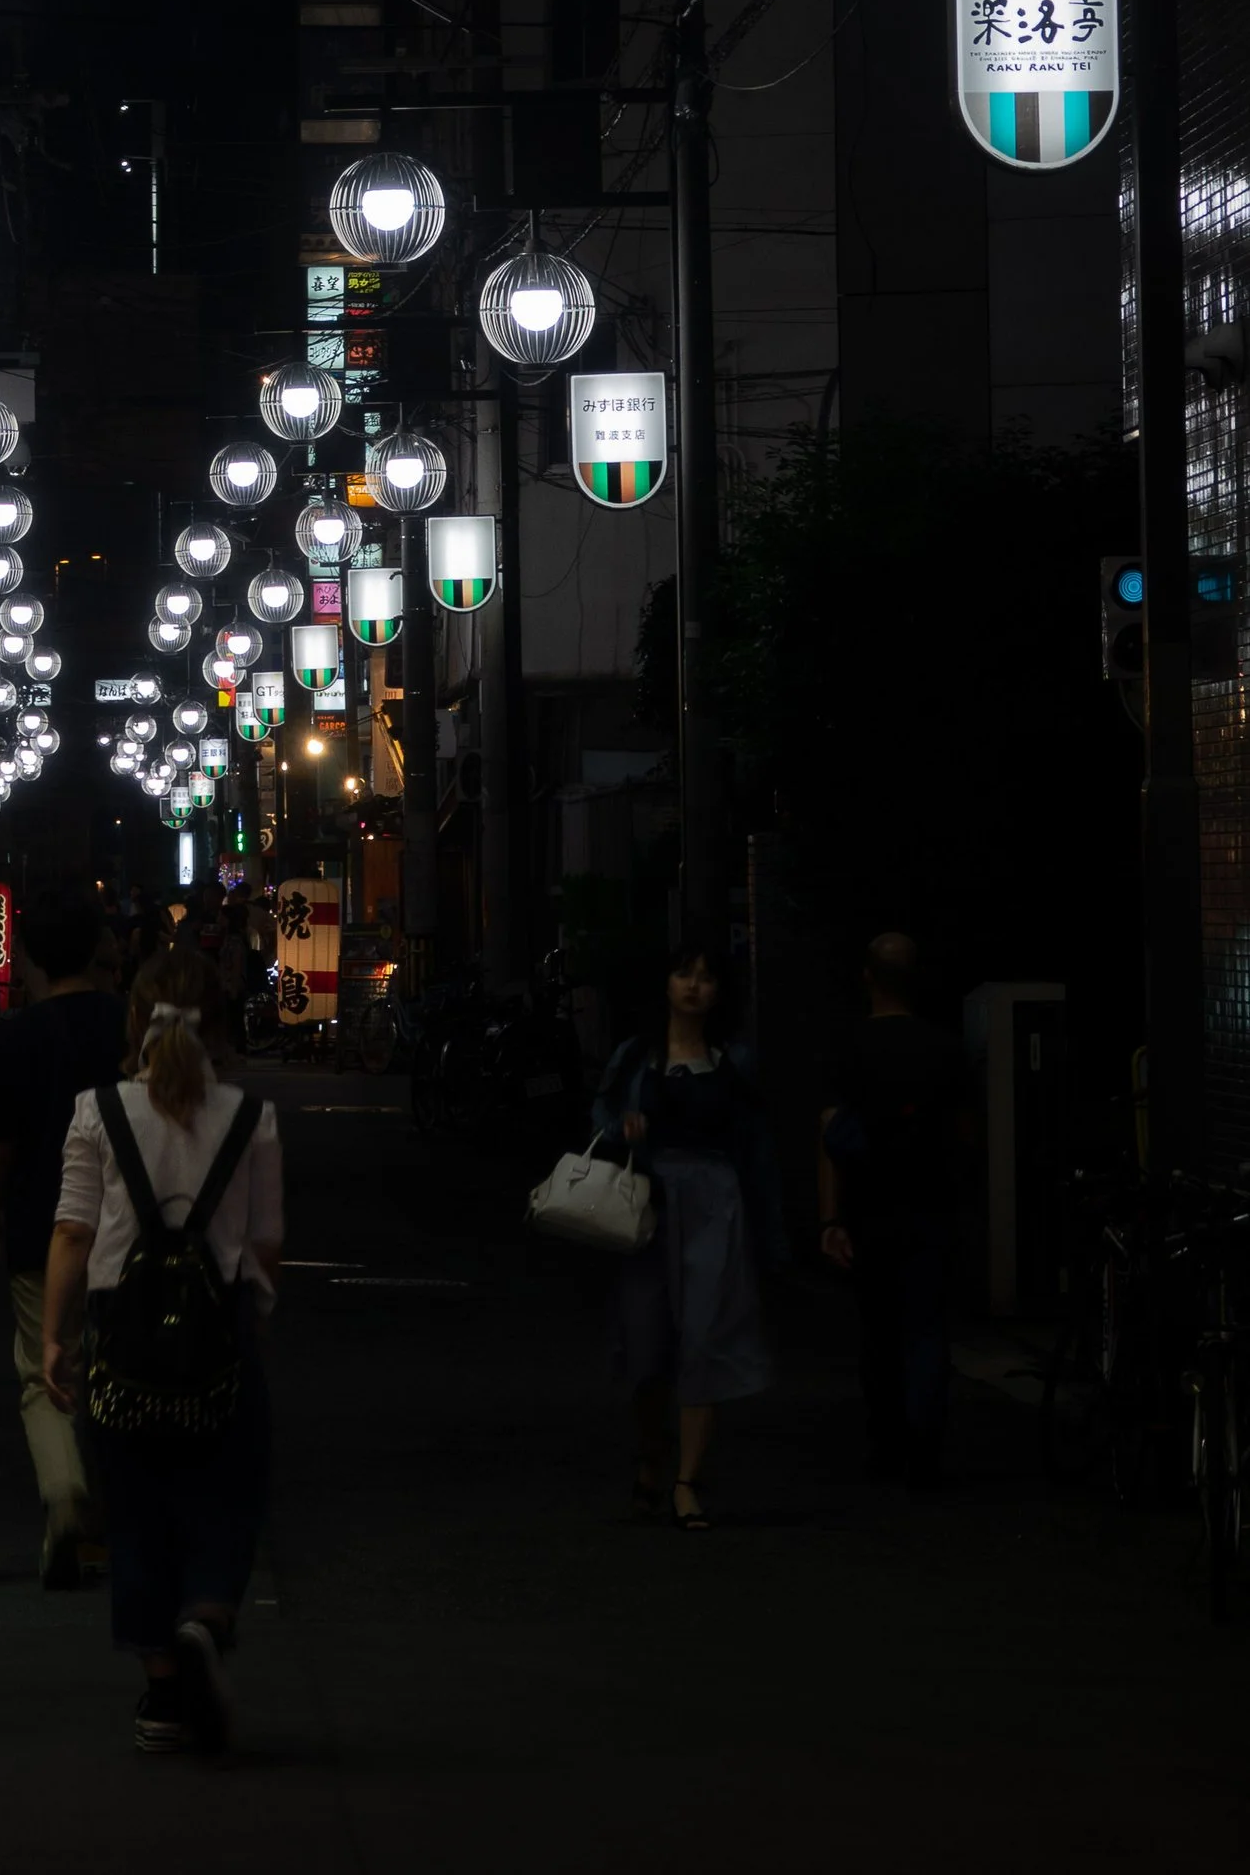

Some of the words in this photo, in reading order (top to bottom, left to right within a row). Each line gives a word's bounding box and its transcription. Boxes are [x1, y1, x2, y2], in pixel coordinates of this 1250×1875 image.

[986, 63, 1022, 72] RAKU
[1029, 63, 1065, 72] RAKU
[1071, 62, 1091, 71] TEI
[582, 398, 656, 413] みずほ銀行
[595, 429, 646, 441] 難波支店
